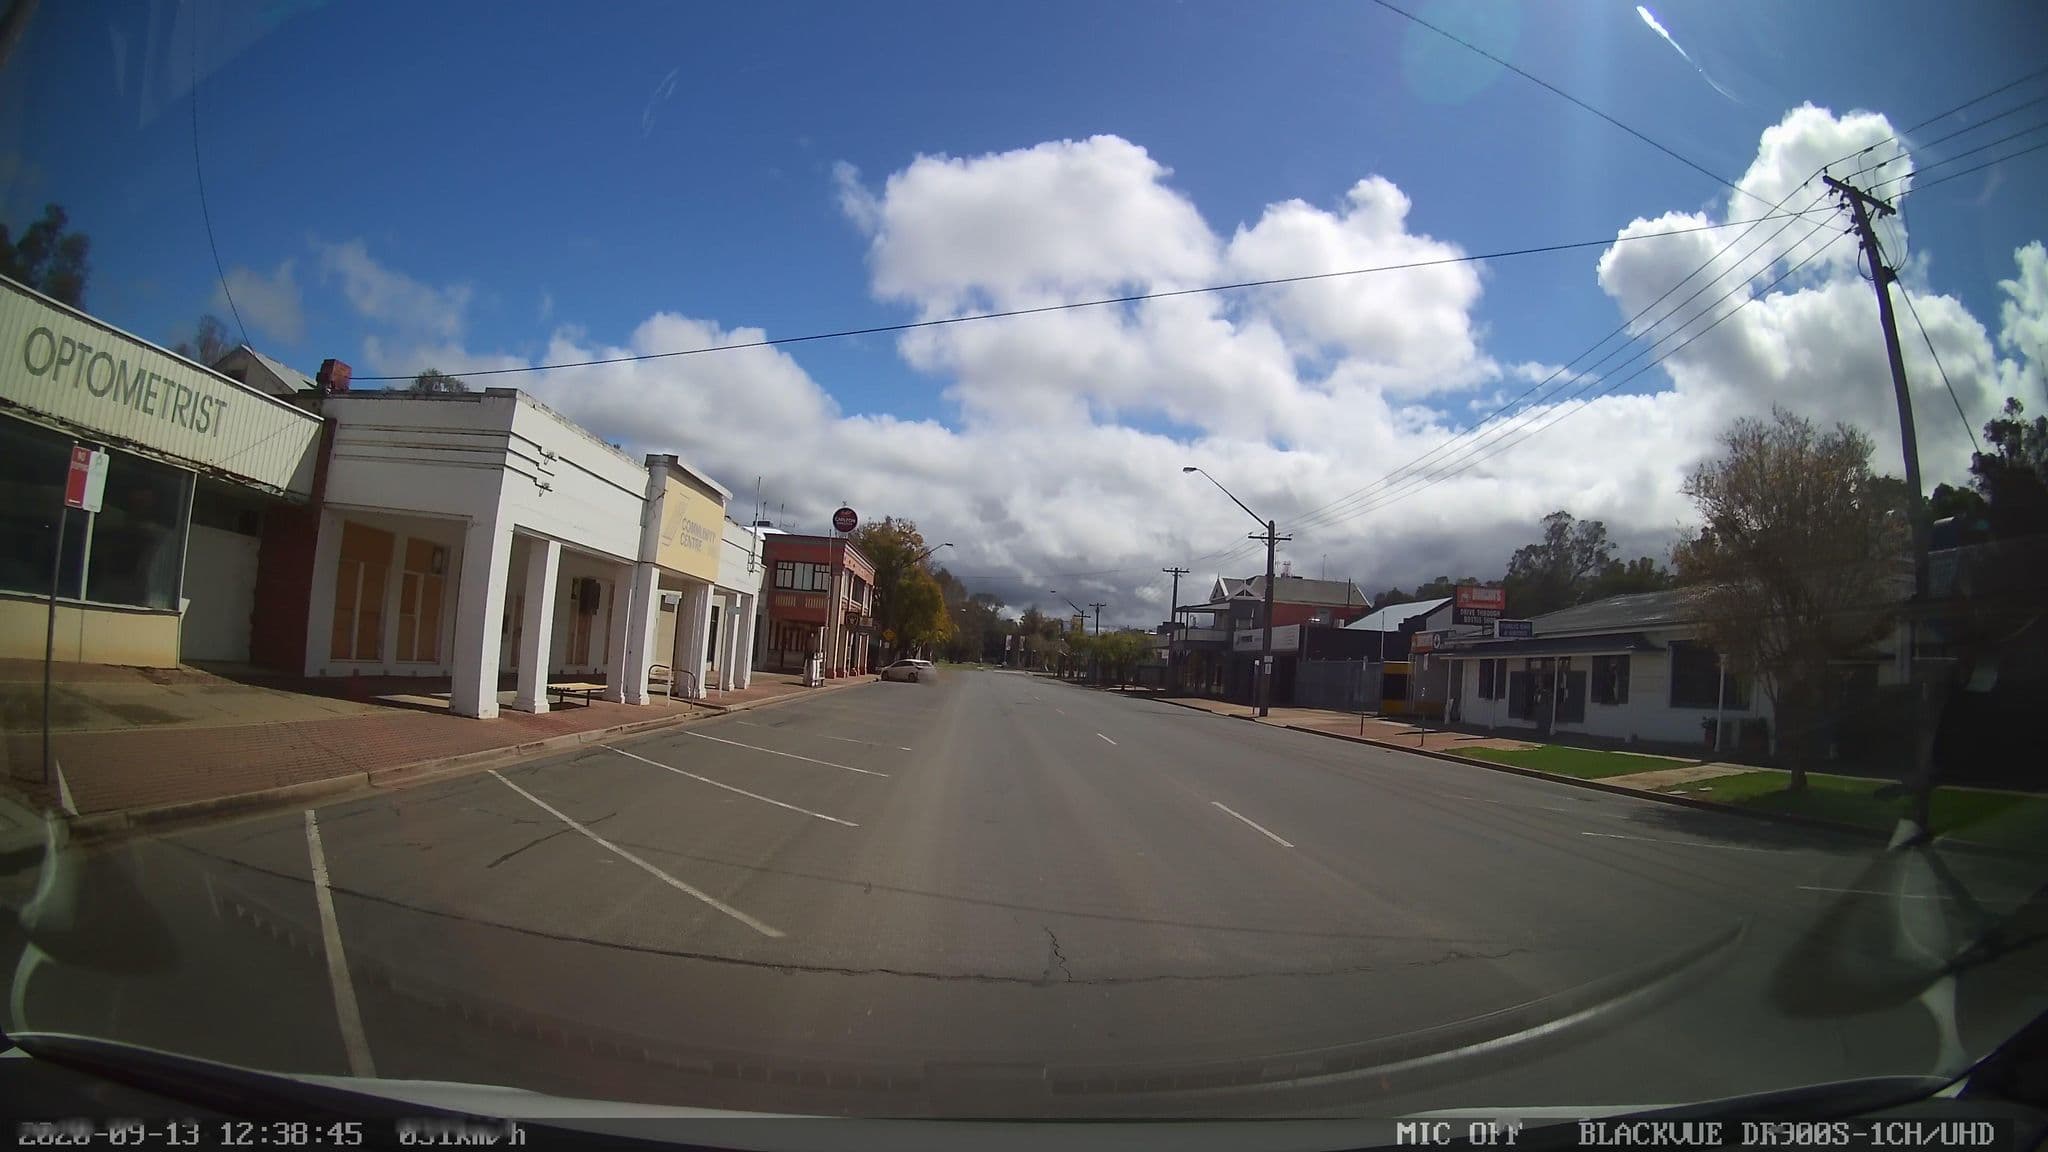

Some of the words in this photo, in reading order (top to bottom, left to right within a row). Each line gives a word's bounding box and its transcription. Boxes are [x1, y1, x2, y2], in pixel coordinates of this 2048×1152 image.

[24, 327, 227, 438] OPTOMETRIST
[680, 532, 703, 552] CENTRE
[682, 517, 717, 543] COMMUNITY
